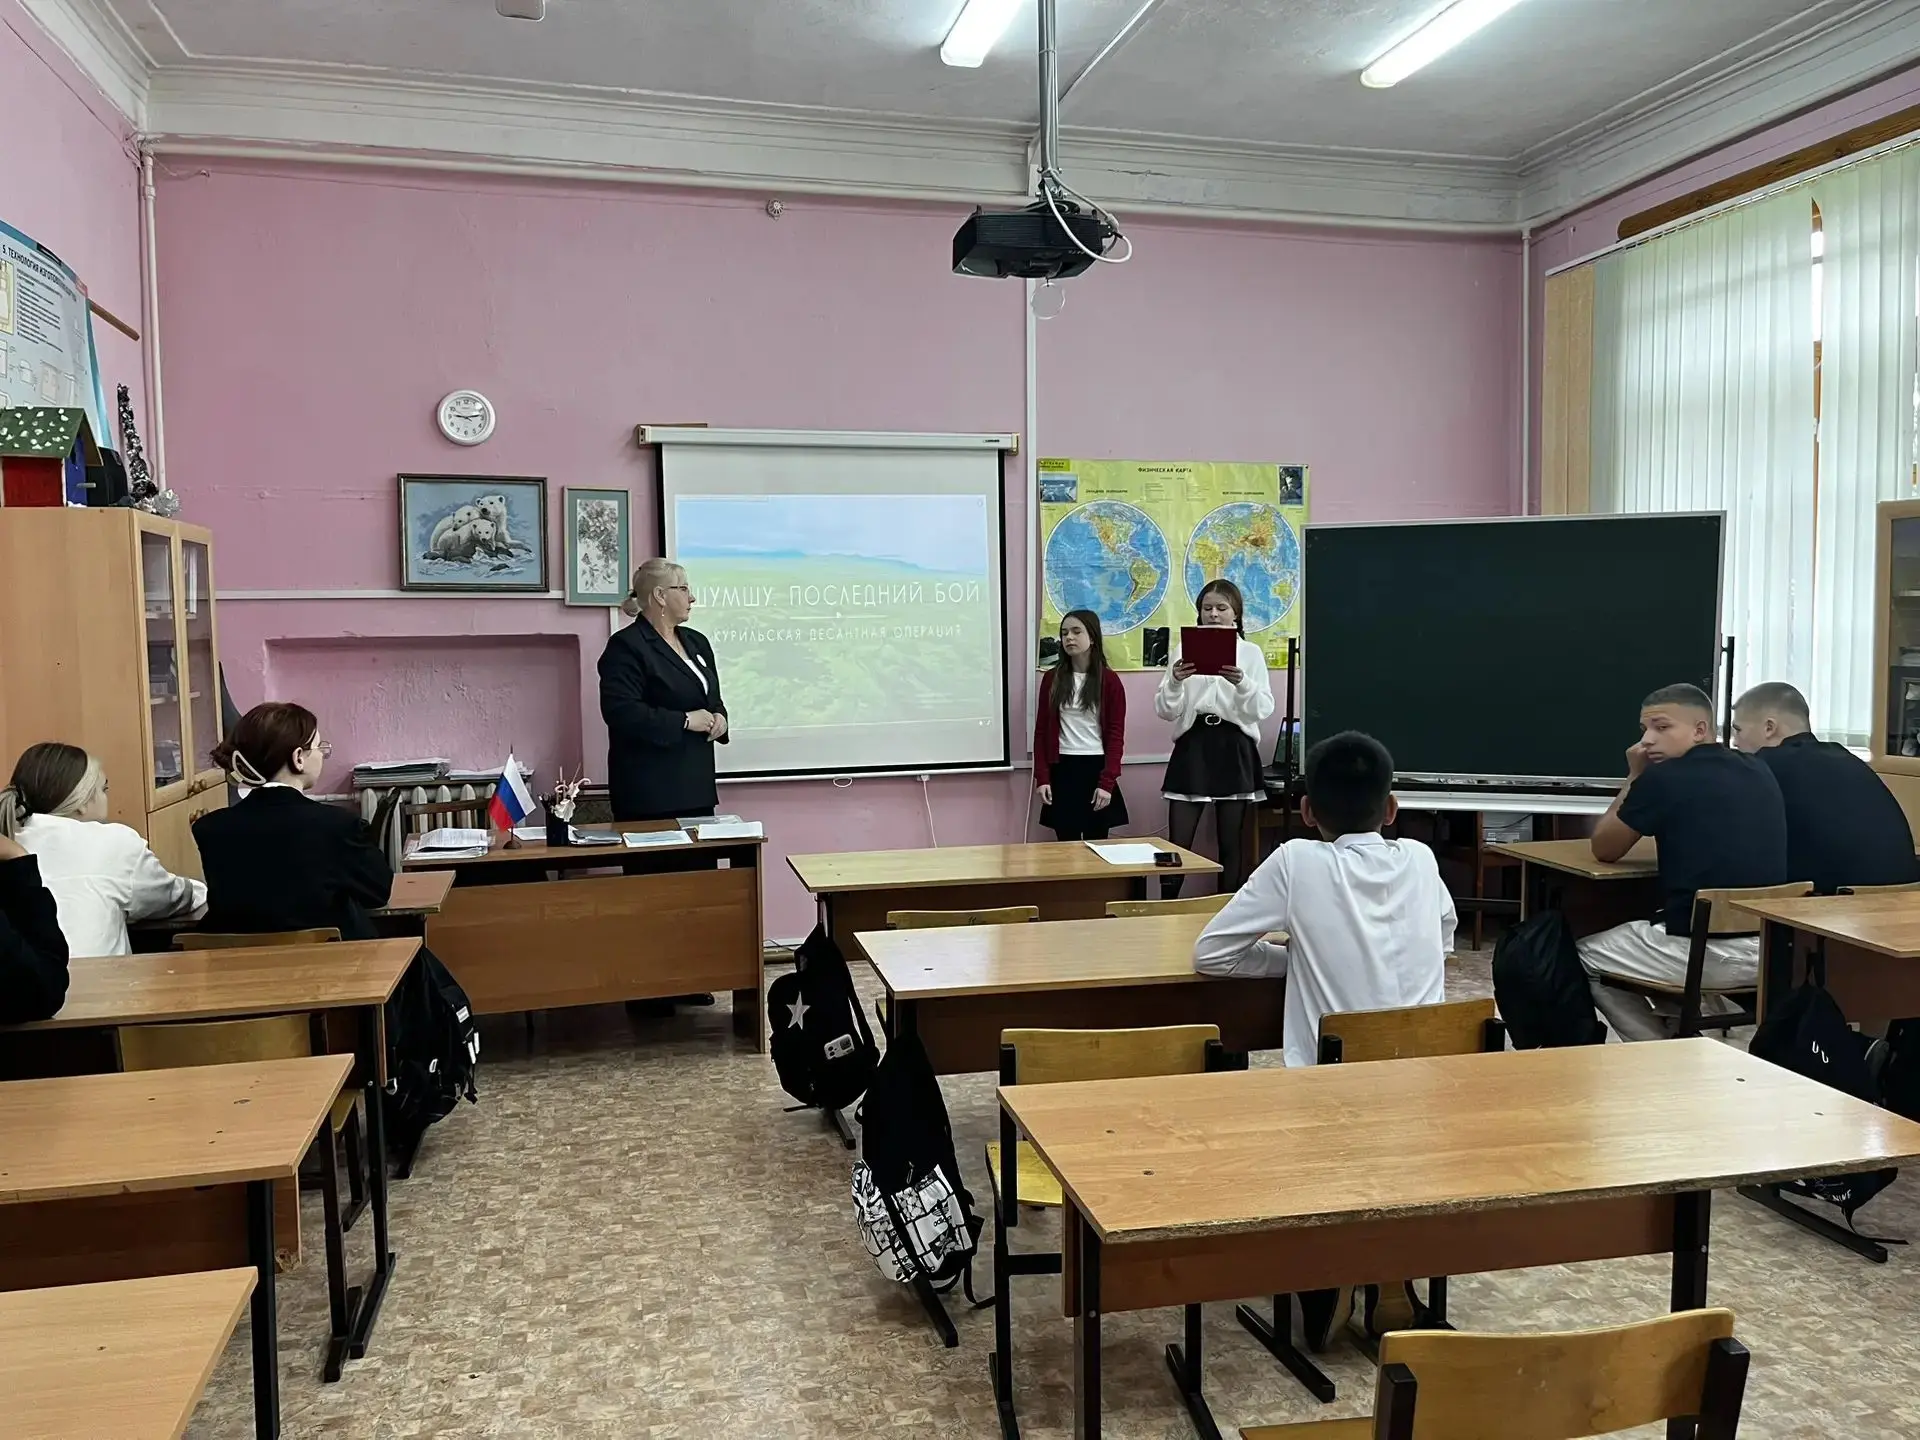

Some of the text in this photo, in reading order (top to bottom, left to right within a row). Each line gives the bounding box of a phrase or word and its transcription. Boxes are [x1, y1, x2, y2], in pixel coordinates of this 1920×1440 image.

[694, 580, 979, 608] ШУМШУ. ПОСЛЕДНИЙ БОЙ
[713, 624, 963, 642] КУРИЛЬСКАЯ ДЕСАНТНАЯ ОПЕРАЦИЯ
